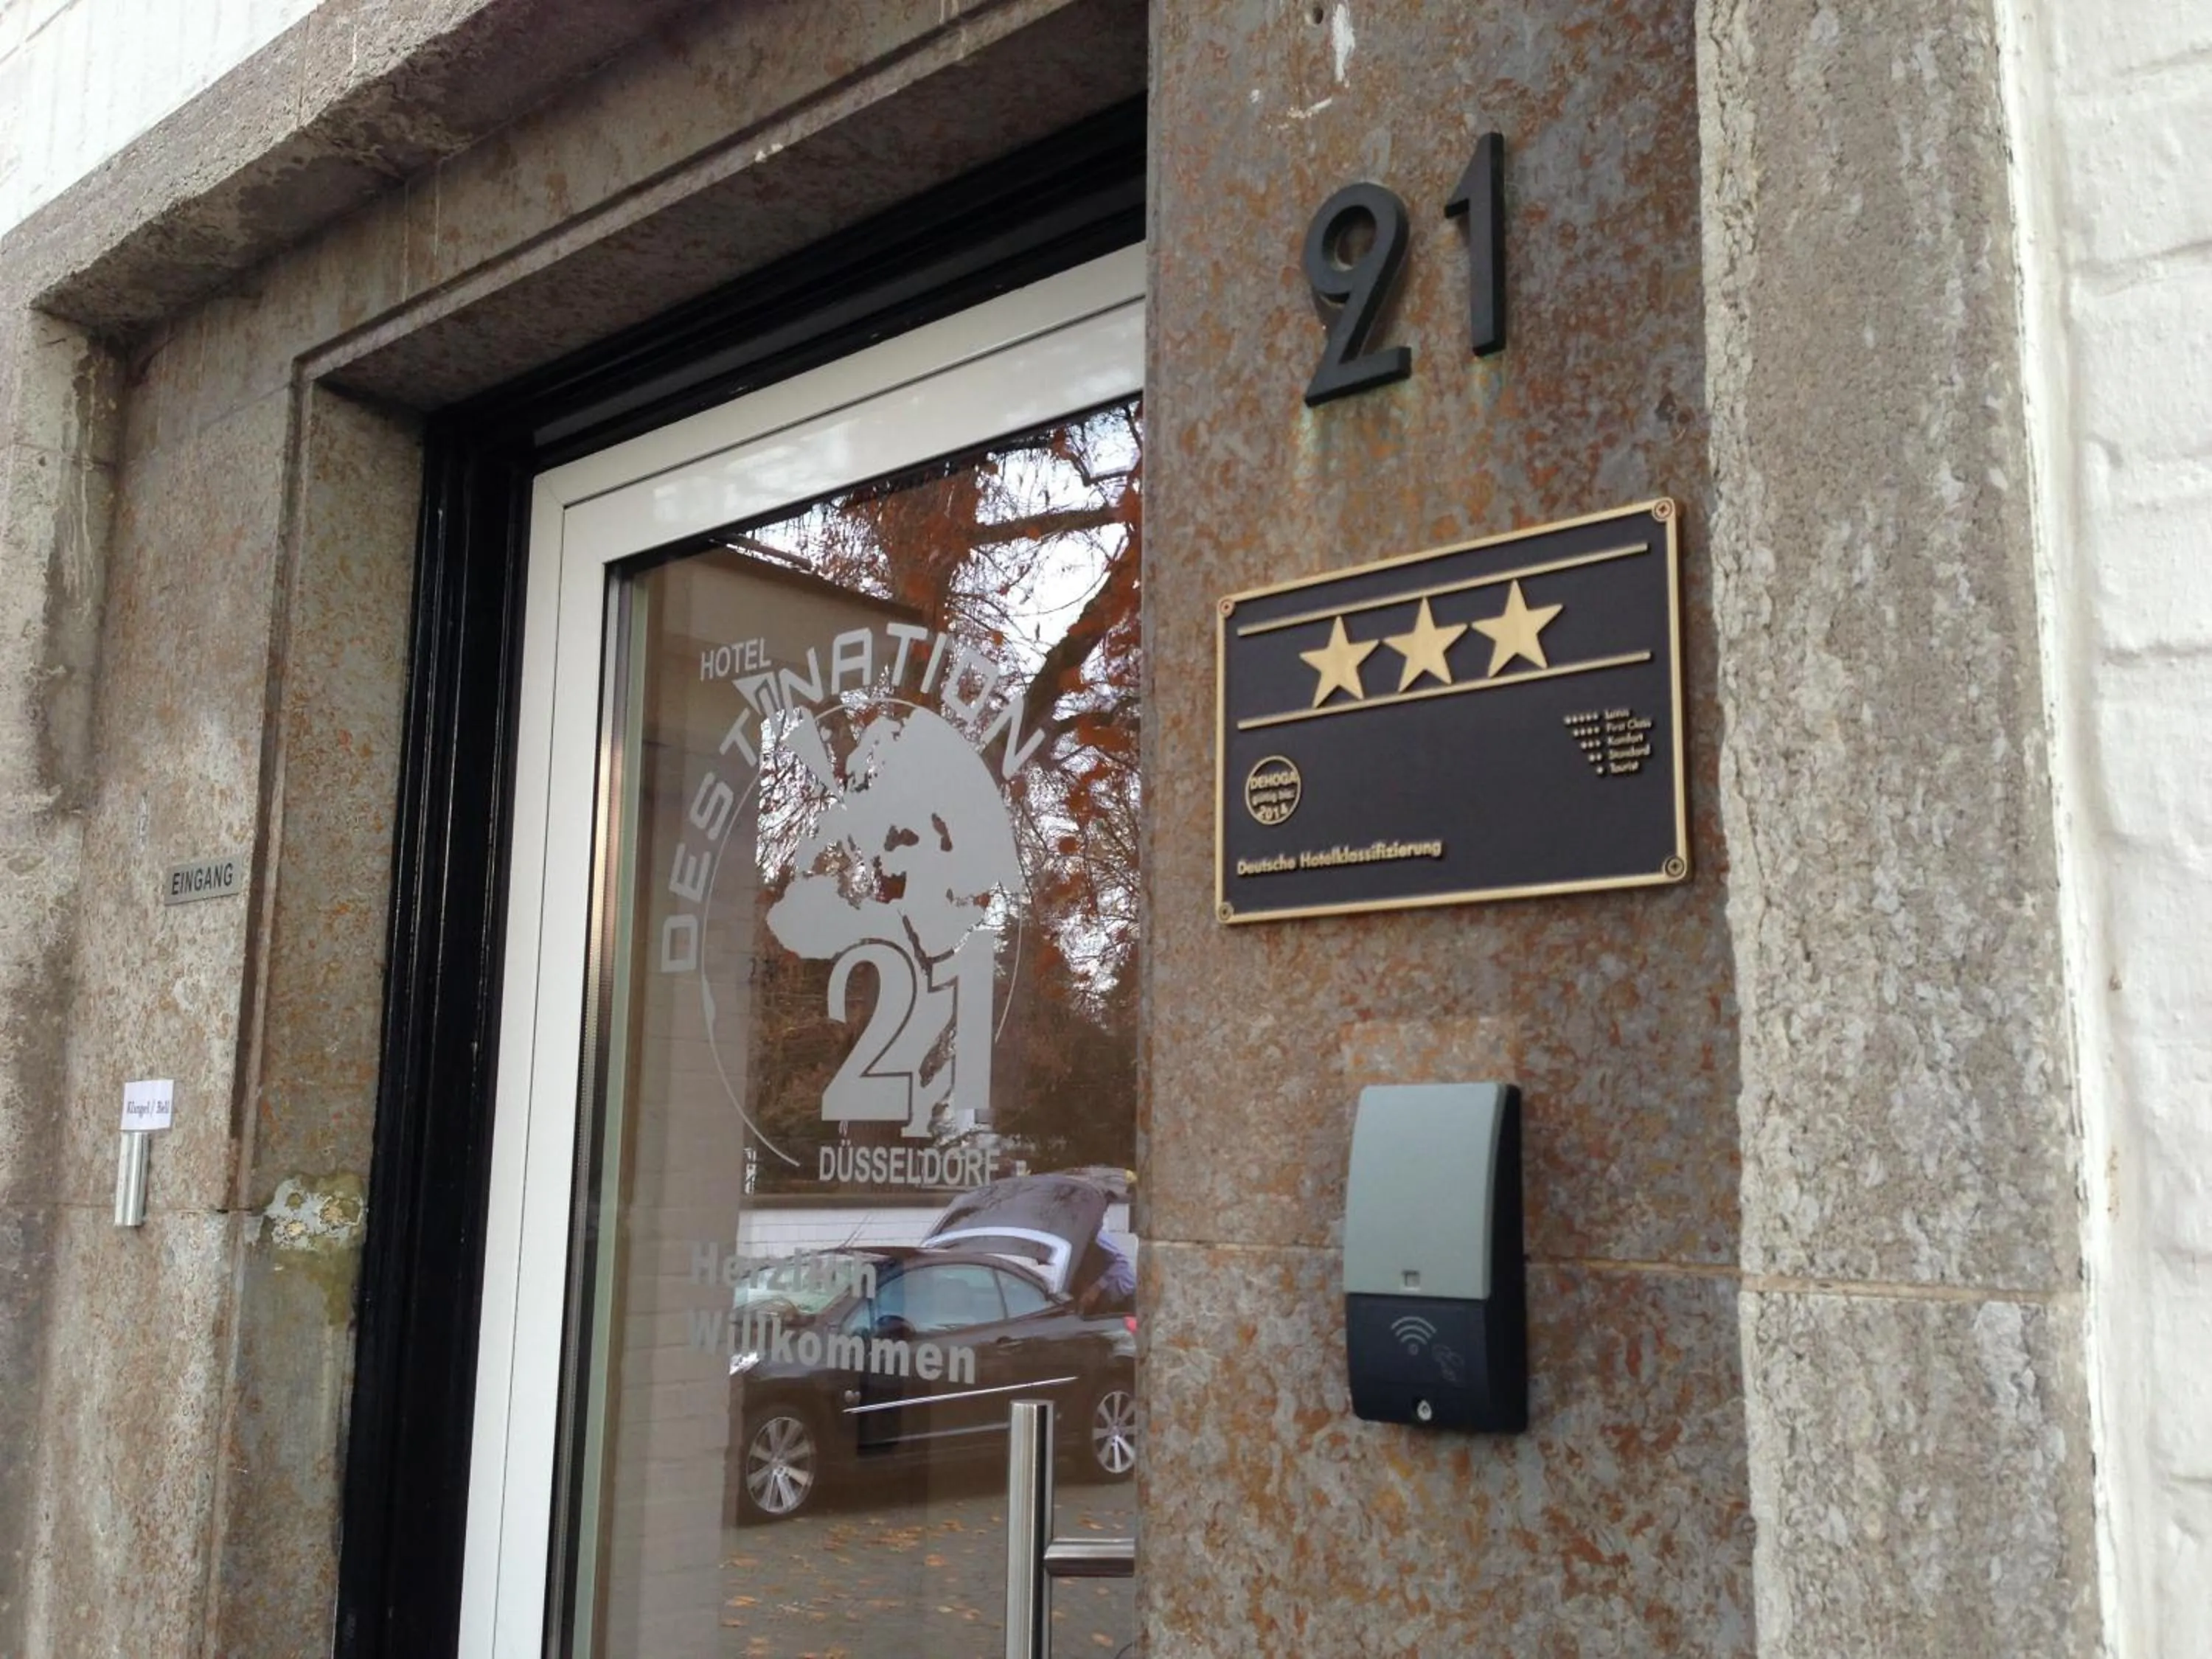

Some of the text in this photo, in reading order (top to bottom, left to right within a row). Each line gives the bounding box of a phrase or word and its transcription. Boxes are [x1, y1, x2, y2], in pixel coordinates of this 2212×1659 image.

[1304, 132, 1506, 407] 21
[700, 637, 772, 681] HOTEL
[1250, 771, 1298, 790] DEHOGA
[171, 863, 234, 895] EINGANG
[1237, 838, 1442, 875] Deutsche Hotelklassifizierung
[821, 936, 994, 1120] 21
[818, 1140, 1001, 1186] DÜSSELDORF
[687, 1308, 975, 1384] Willkommen
